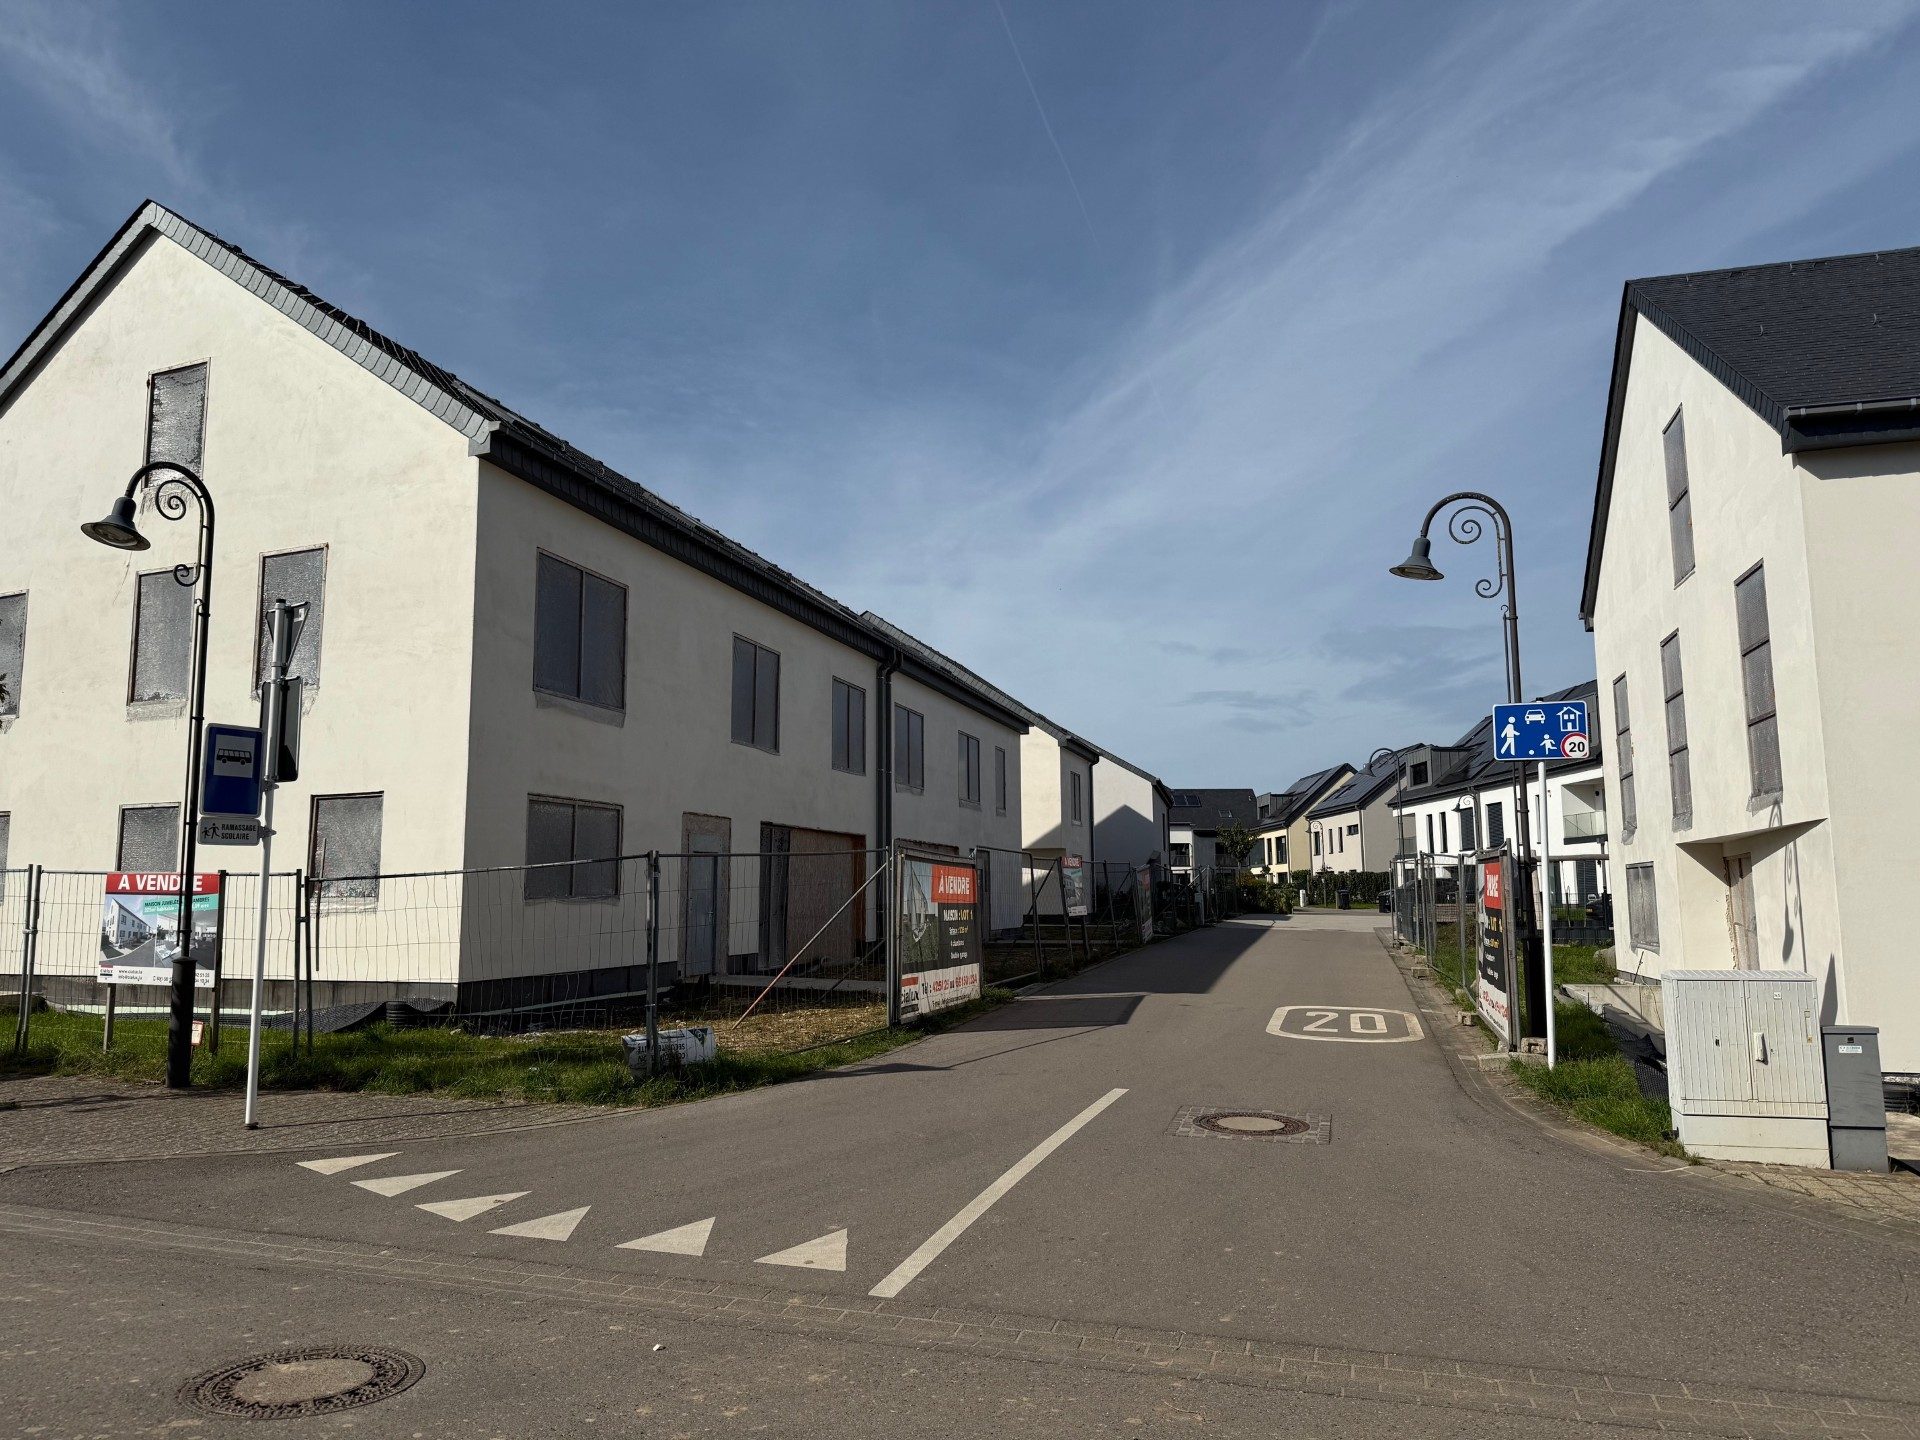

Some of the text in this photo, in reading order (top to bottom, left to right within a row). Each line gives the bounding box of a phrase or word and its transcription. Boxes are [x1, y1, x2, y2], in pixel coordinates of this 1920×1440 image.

[1568, 741, 1586, 753] 20
[221, 823, 257, 832] RAMASSAGE
[220, 832, 250, 840] SCOLAIRE
[118, 874, 204, 892] A VENDE
[938, 869, 970, 895] À VENDRE
[943, 909, 959, 922] MAISON
[961, 909, 969, 921] LOT
[1303, 1011, 1388, 1034] 20
